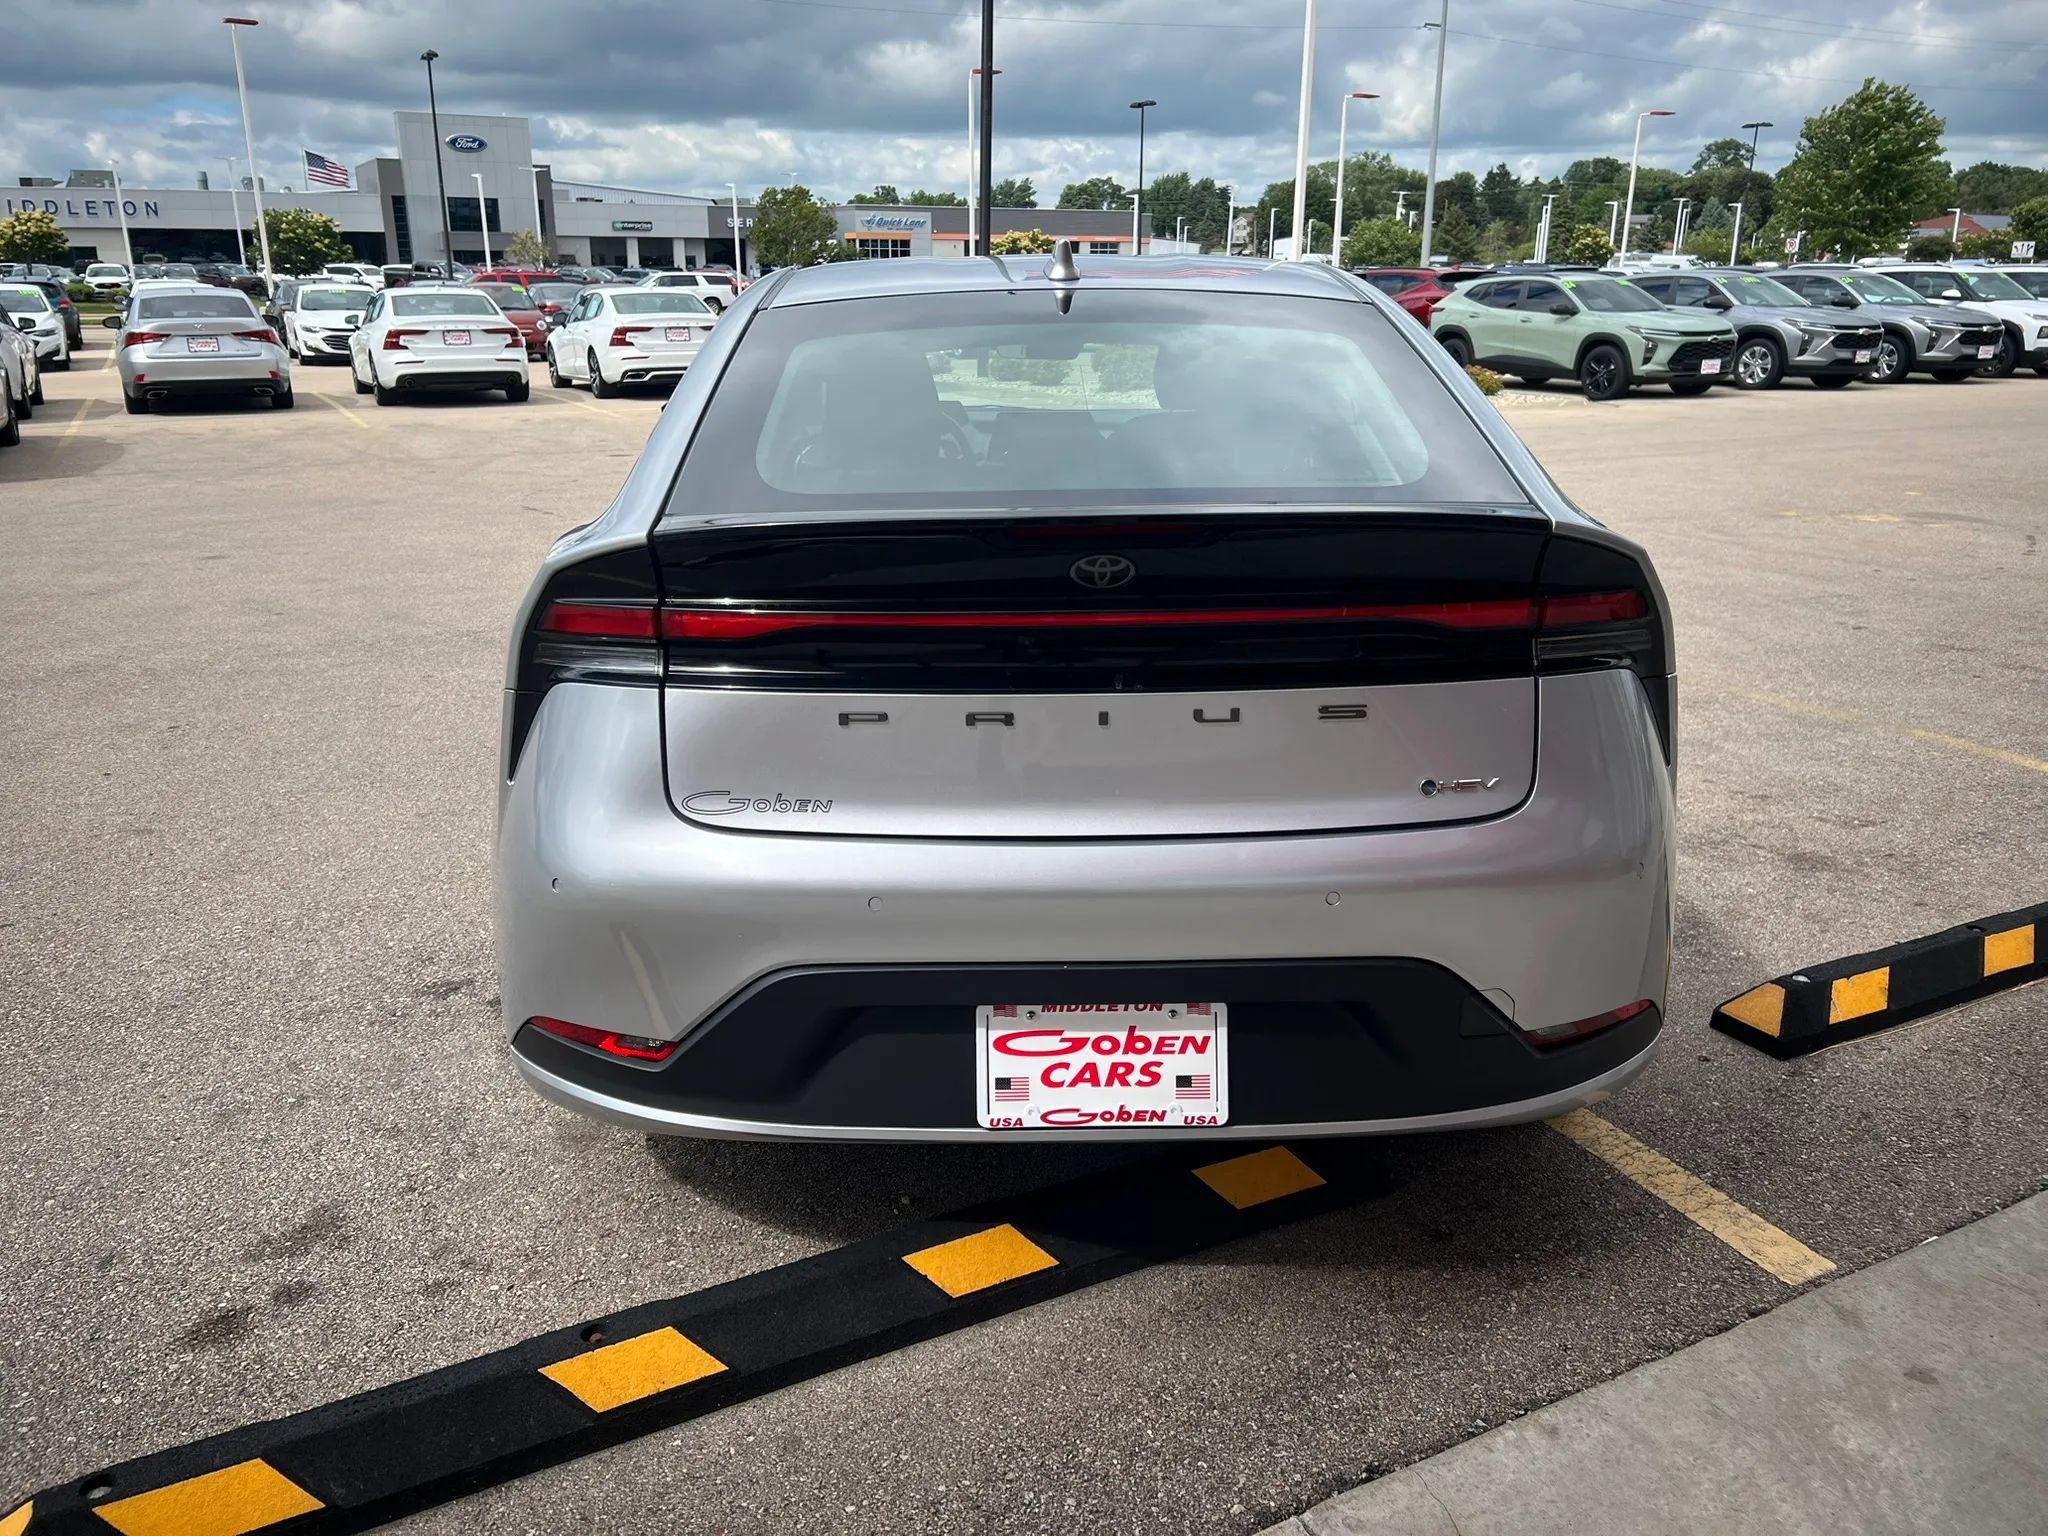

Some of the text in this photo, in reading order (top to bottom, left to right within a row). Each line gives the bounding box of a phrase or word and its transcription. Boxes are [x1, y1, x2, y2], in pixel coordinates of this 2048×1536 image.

[455, 137, 480, 149] Ford
[726, 217, 758, 228] SER
[876, 217, 927, 227] Quick Lane
[838, 703, 1368, 727] PRIUS
[1438, 777, 1500, 793] HEV
[1040, 1003, 1163, 1013] MIDDLETON
[1040, 1061, 1164, 1089] CARS
[989, 1117, 1024, 1128] USA
[1183, 1115, 1218, 1126] USA
